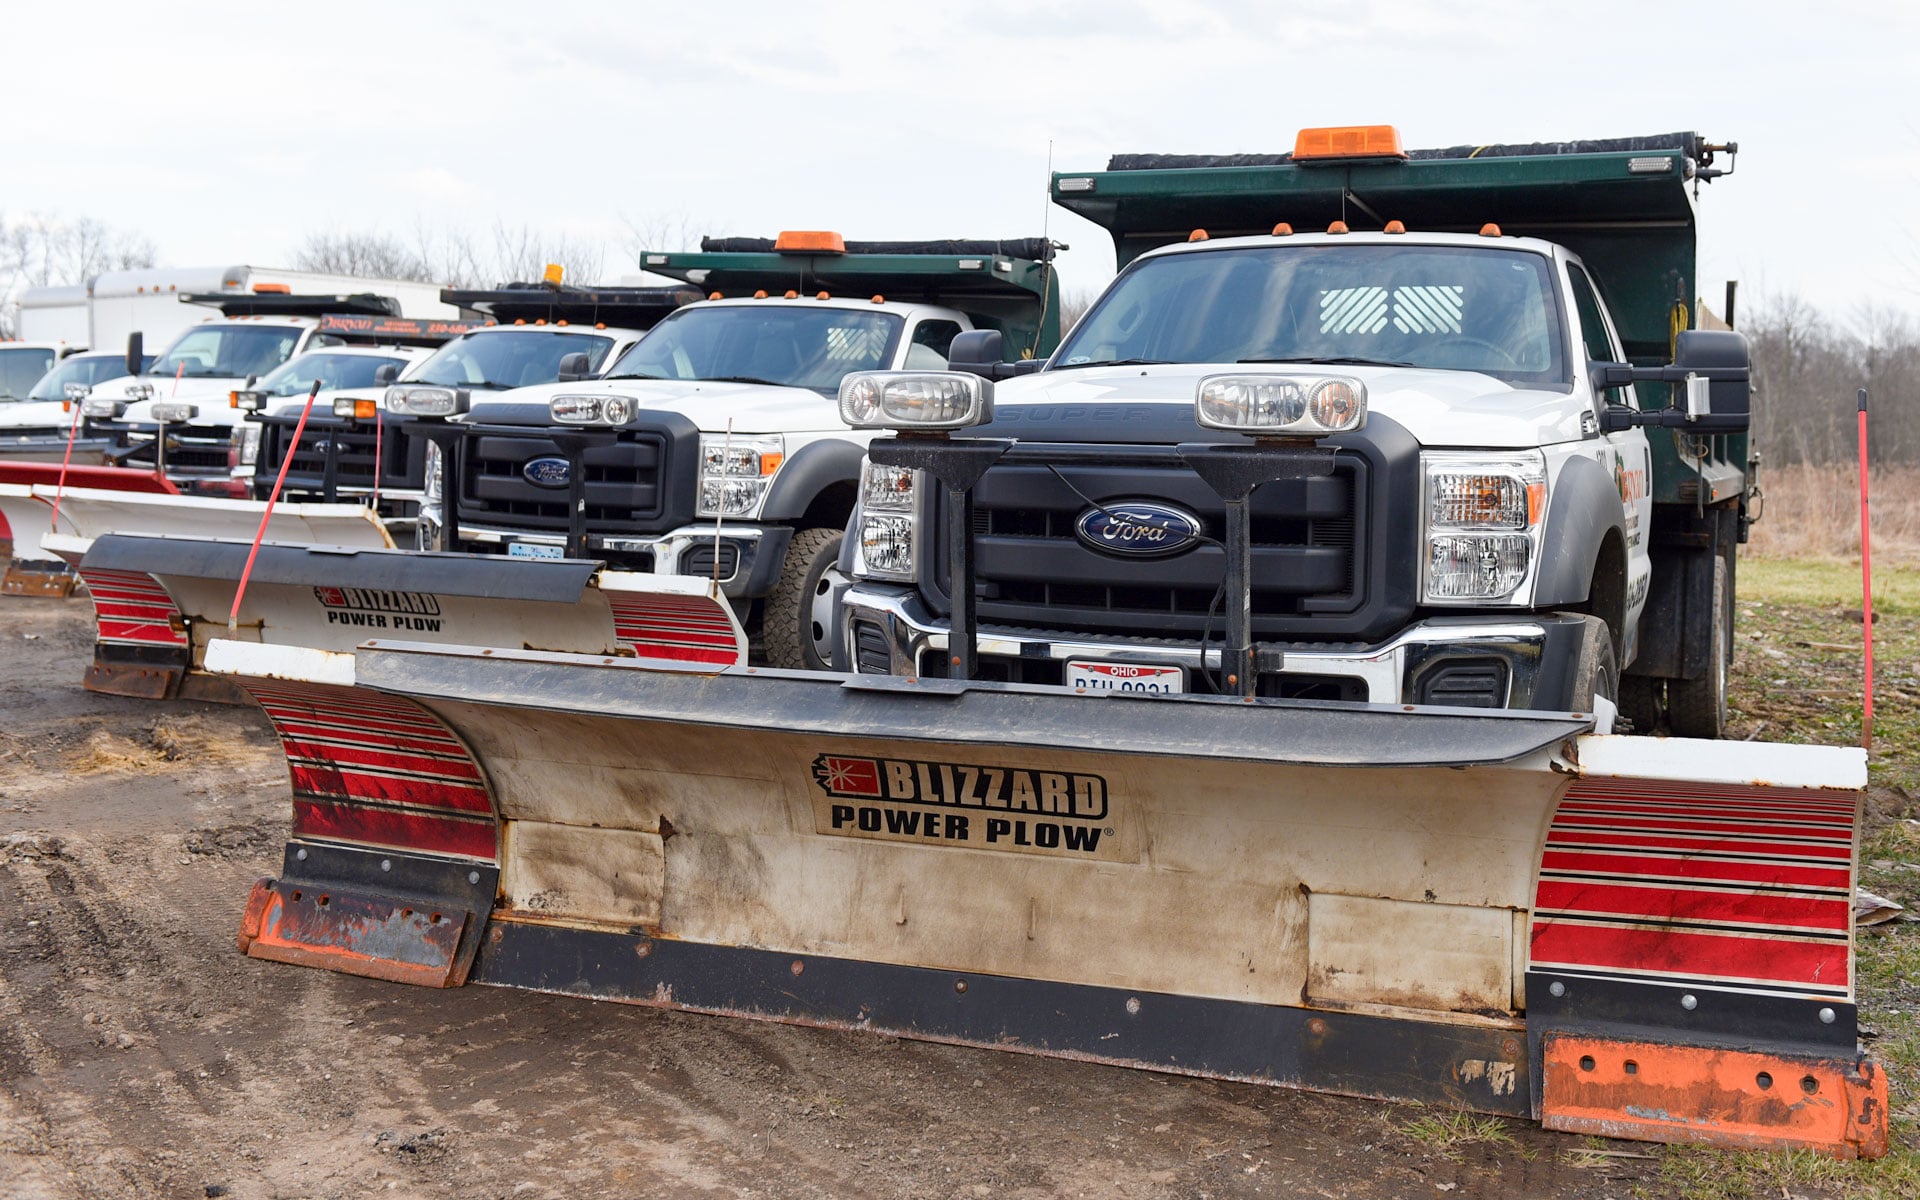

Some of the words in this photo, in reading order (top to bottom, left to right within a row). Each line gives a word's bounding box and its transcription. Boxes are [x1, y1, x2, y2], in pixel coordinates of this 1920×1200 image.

[994, 406, 1151, 423] SUPER
[1102, 511, 1169, 542] Ford
[342, 588, 439, 615] BLIZZARD
[327, 611, 387, 628] POWER
[393, 616, 440, 632] PLOW
[1110, 667, 1139, 677] OHIO
[884, 759, 1104, 817] BLIZZARD
[831, 804, 970, 841] POWER
[986, 818, 1102, 852] PLOW
